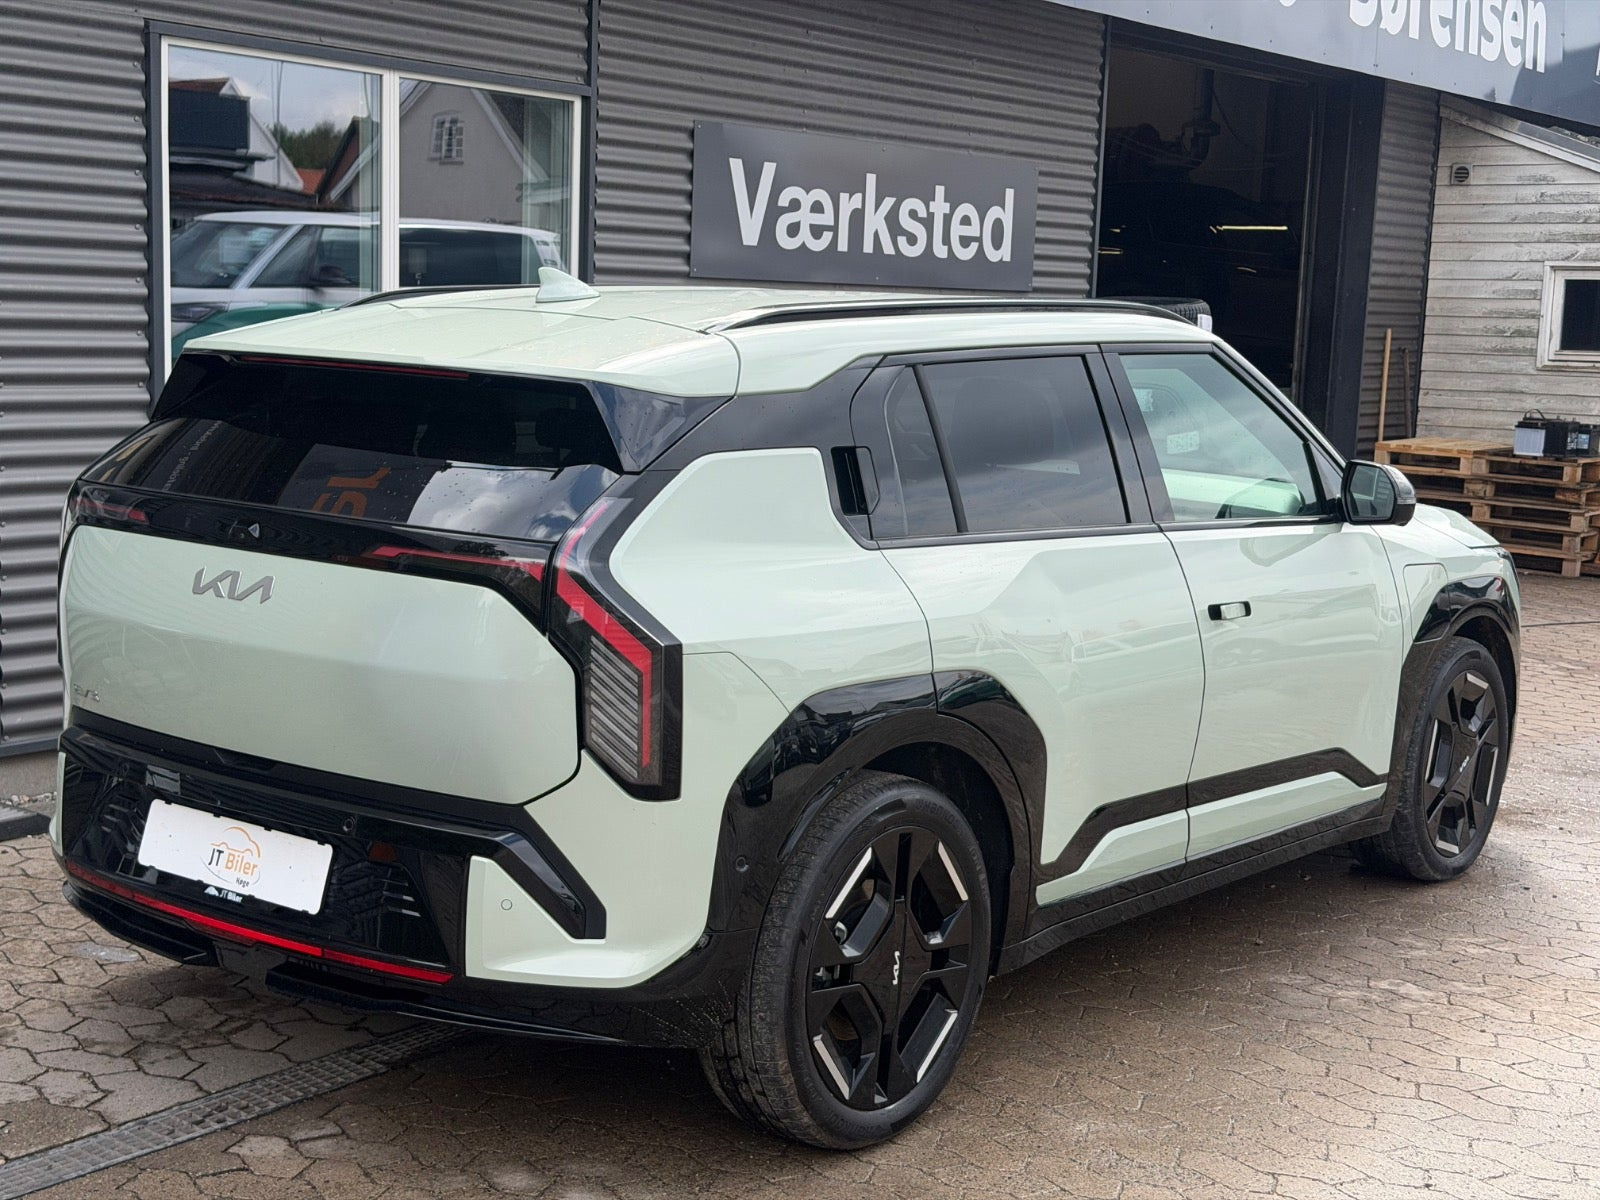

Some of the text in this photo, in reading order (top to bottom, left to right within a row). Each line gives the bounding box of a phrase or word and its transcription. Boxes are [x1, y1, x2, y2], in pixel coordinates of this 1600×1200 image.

[1350, 0, 1546, 73] ensen
[729, 157, 1014, 262] Værksted
[192, 565, 275, 604] KIA
[208, 848, 257, 876] JT Biler
